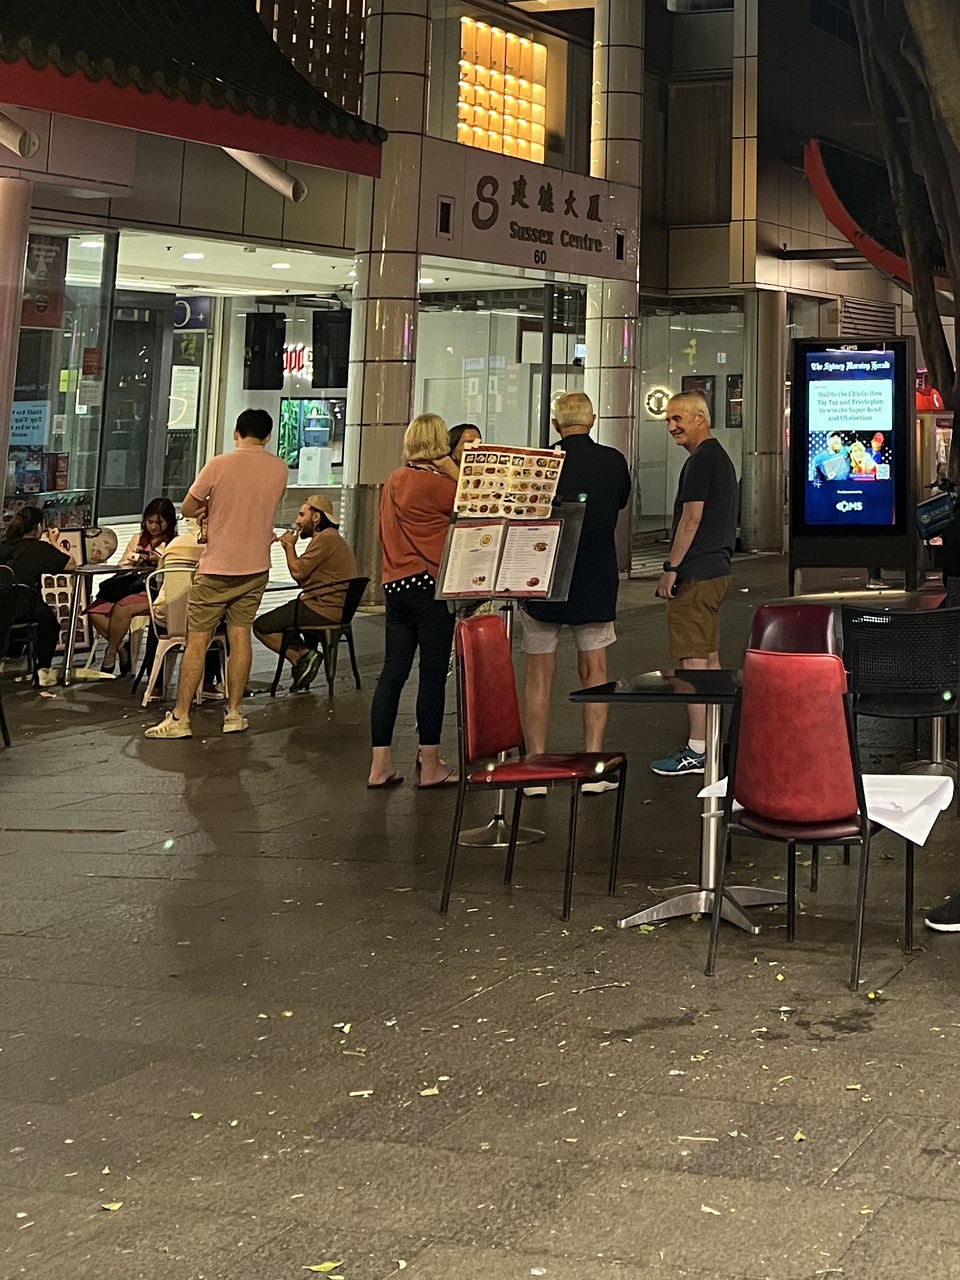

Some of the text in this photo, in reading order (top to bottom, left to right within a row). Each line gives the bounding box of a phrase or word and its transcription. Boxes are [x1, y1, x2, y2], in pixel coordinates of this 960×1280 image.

[509, 221, 602, 252] Sussex Centre
[534, 250, 547, 264] 60
[823, 361, 845, 372] Sydney
[846, 361, 870, 371] Morning
[871, 360, 891, 371] Herald
